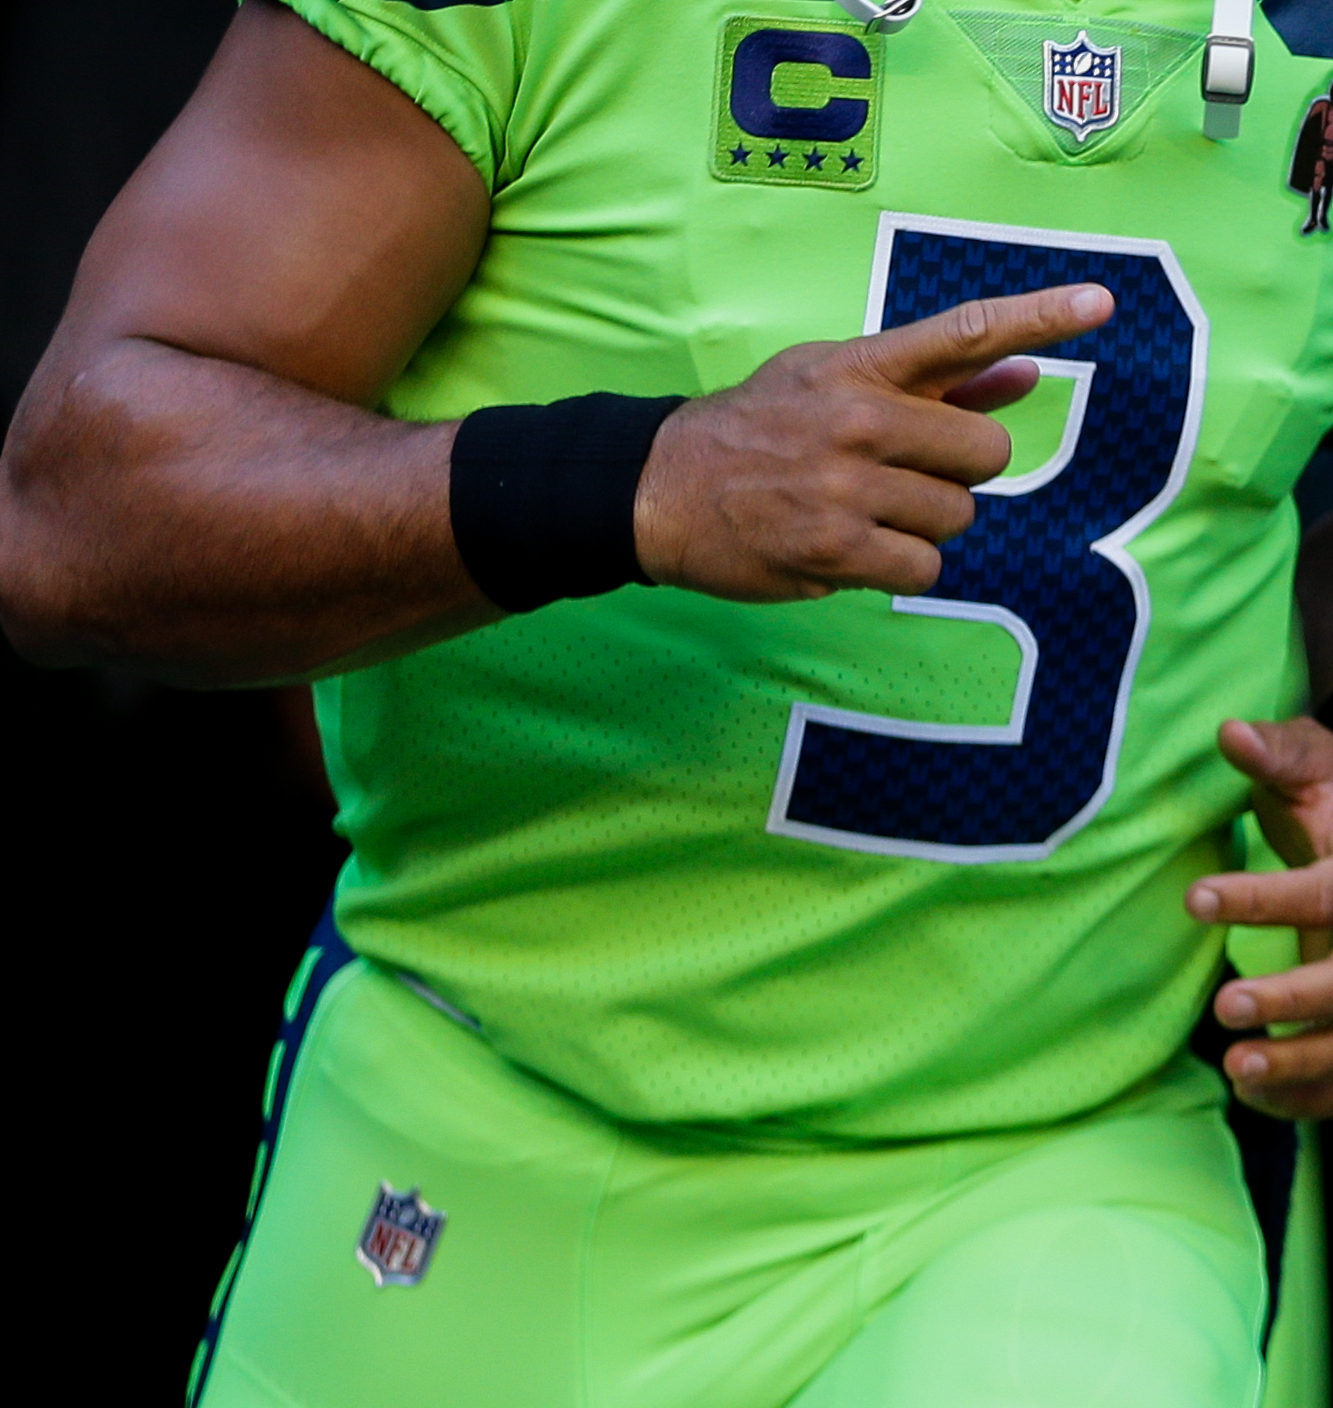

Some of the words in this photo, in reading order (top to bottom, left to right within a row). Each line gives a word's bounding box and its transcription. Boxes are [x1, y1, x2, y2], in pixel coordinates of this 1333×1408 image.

[730, 29, 872, 142] C
[1057, 79, 1109, 119] NFL
[767, 210, 1209, 862] 3
[367, 1220, 422, 1275] NFL
